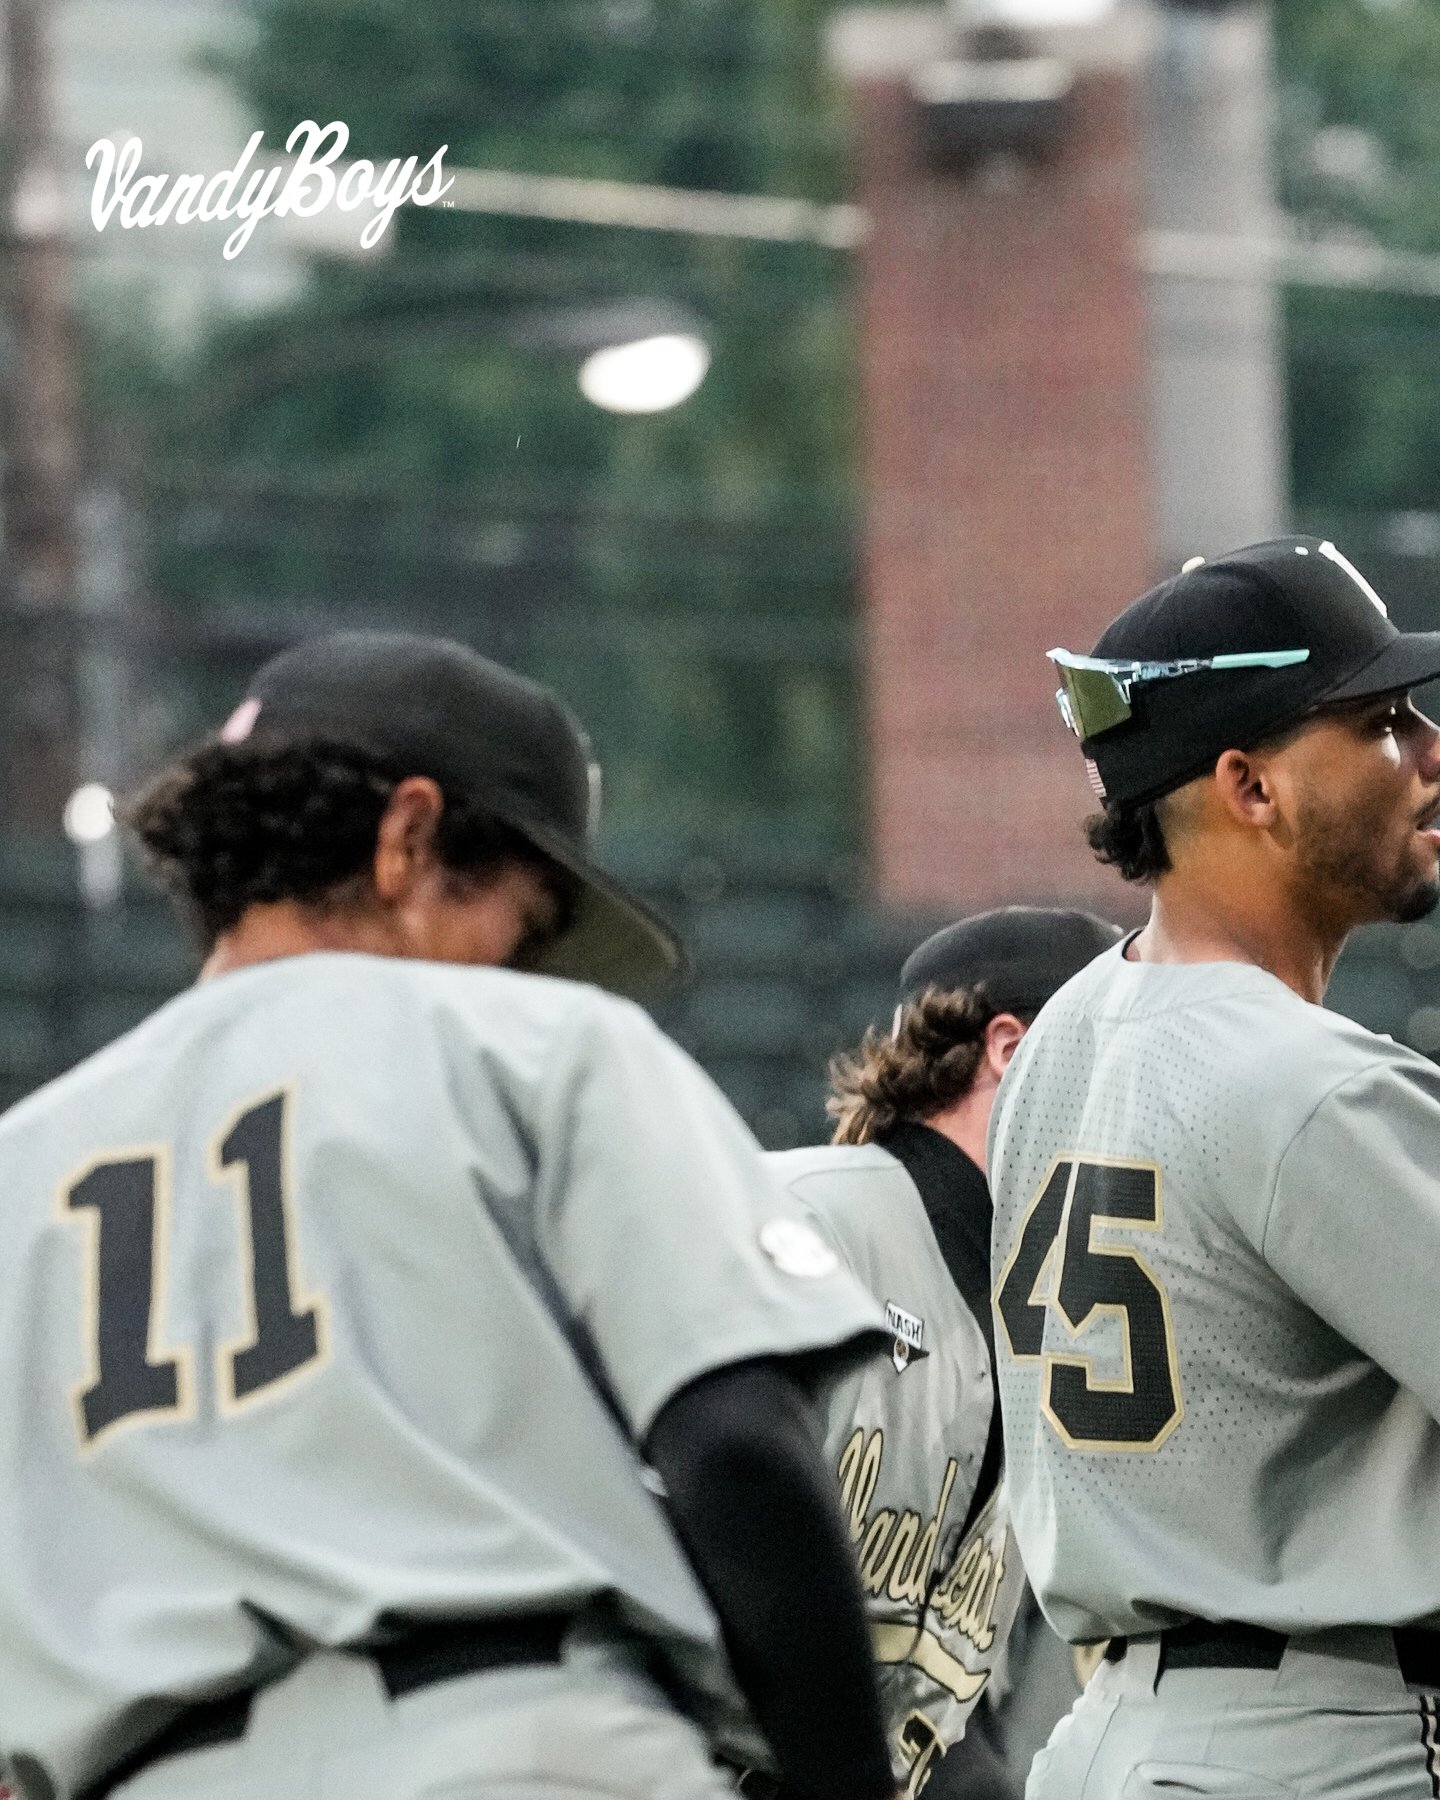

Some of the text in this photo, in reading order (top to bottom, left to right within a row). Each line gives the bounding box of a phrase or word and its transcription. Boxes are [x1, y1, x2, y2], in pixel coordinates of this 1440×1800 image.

[53, 1078, 334, 1458] 11
[886, 1307, 921, 1343] NASH
[991, 1152, 1184, 1451] 45
